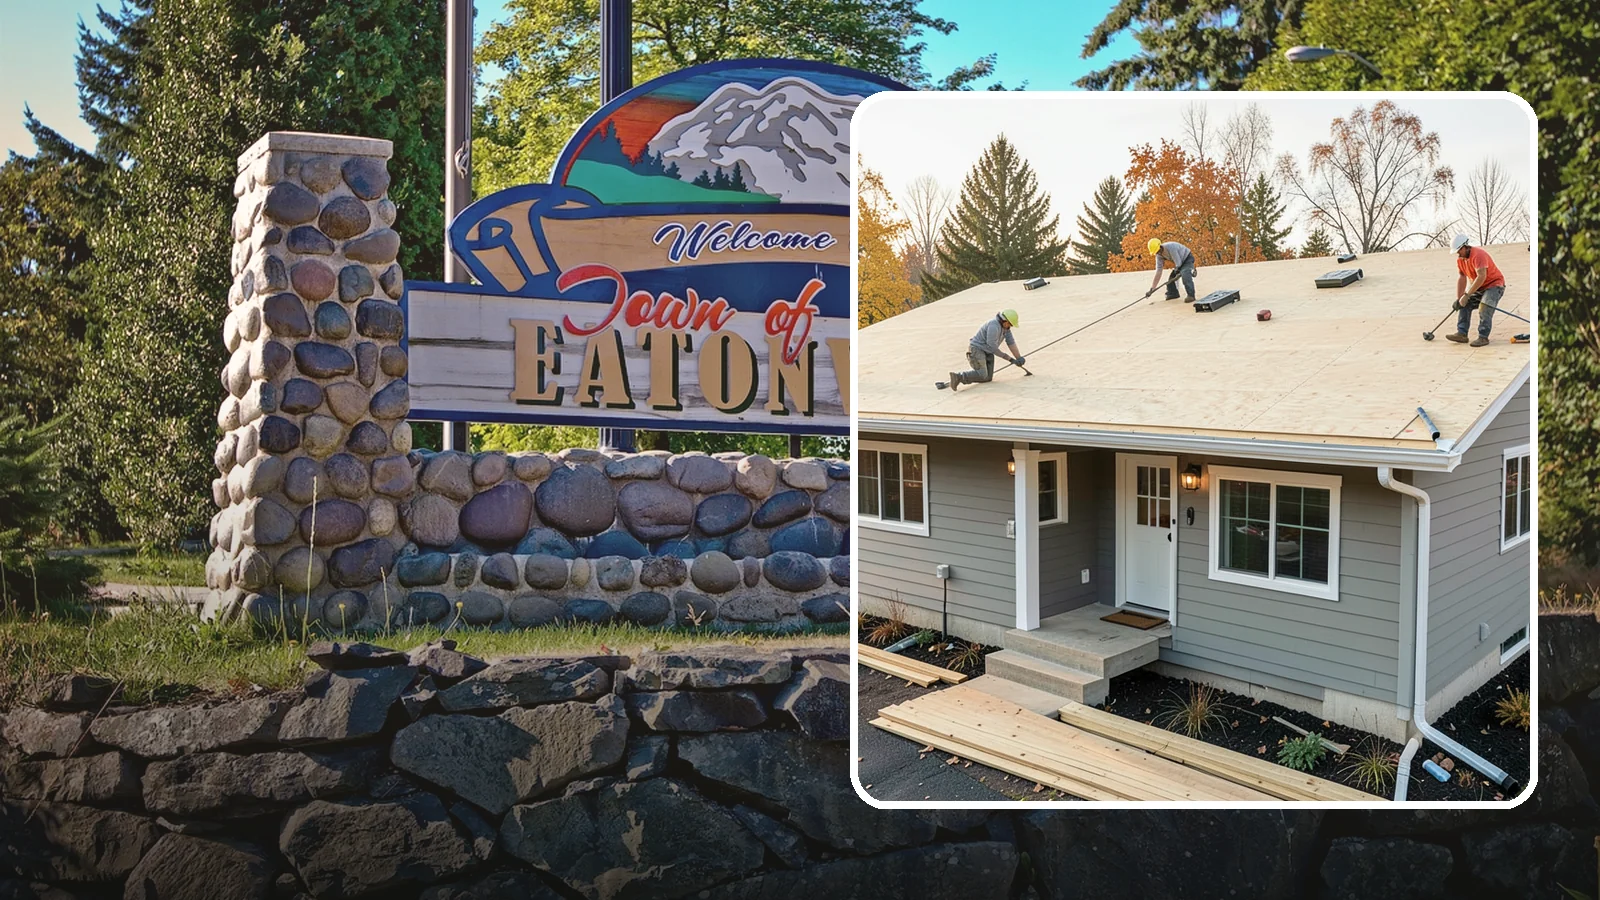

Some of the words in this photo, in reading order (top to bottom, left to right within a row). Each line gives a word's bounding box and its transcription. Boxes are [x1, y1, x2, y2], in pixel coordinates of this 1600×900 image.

[653, 221, 837, 263] Welcome
[556, 263, 737, 336] Town
[764, 279, 826, 365] of
